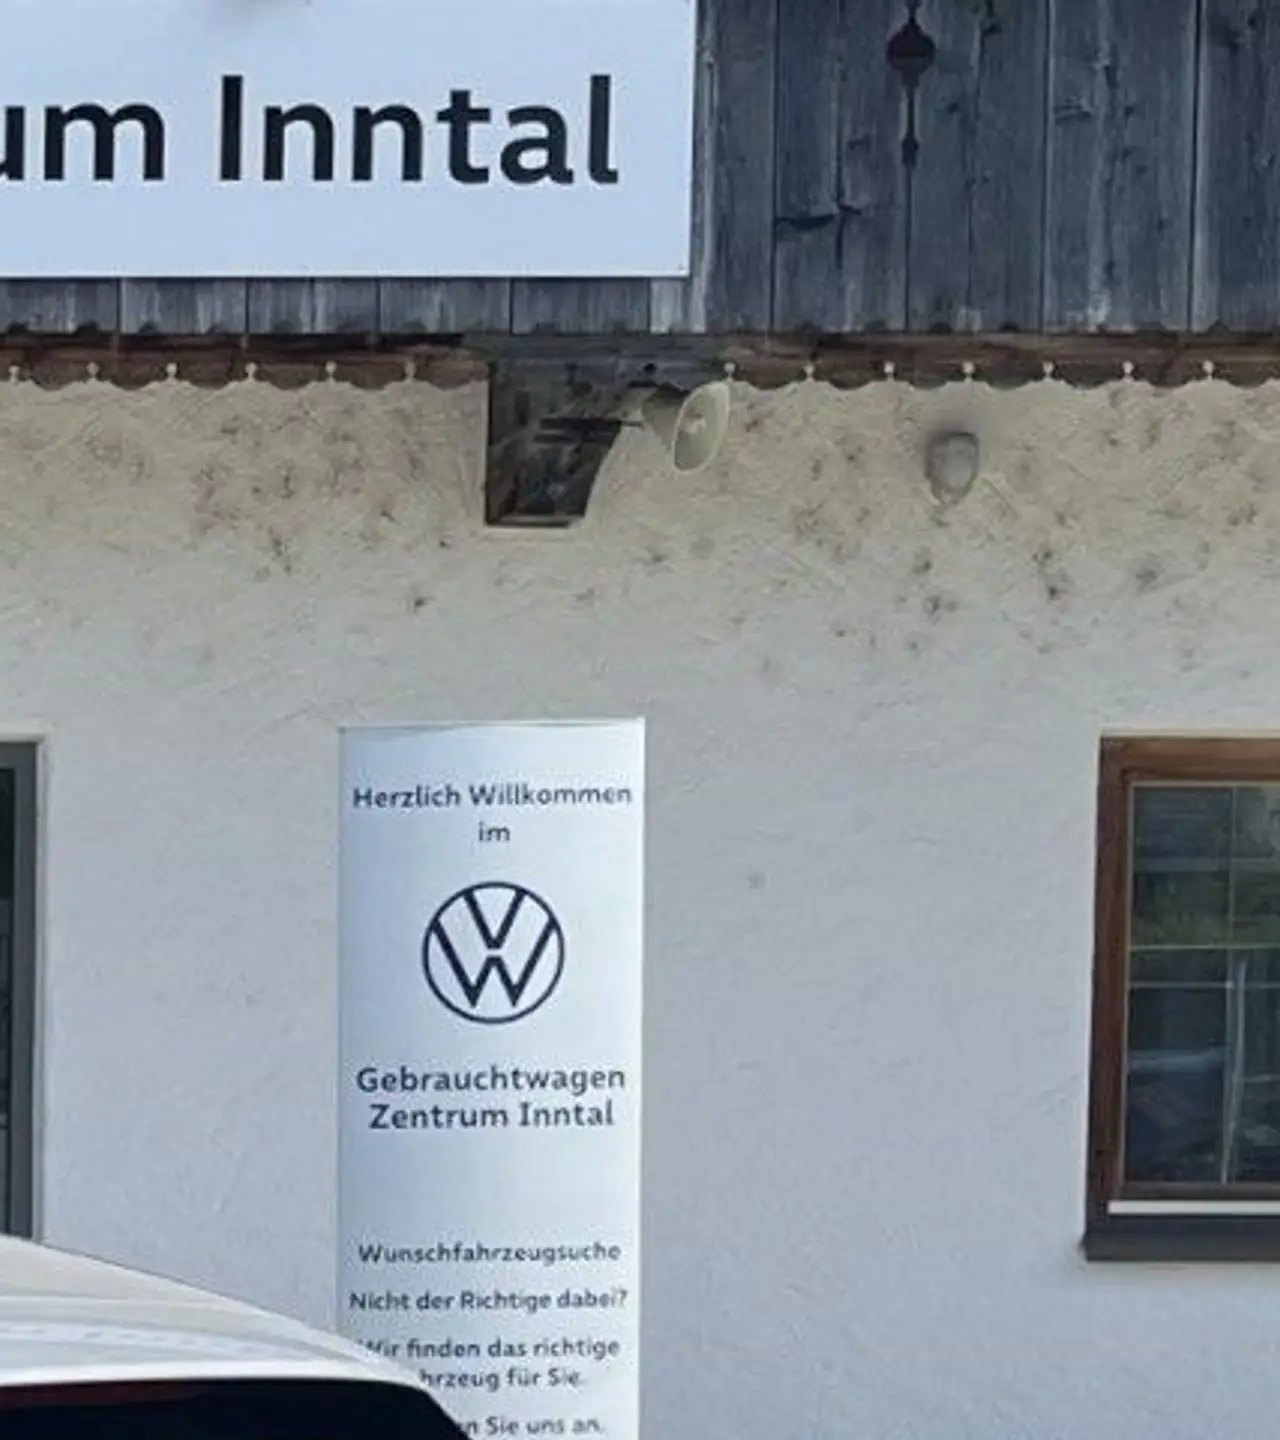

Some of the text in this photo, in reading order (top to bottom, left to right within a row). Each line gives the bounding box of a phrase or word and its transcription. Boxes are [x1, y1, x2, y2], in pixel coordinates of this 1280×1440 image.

[220, 73, 619, 187] Inntal
[352, 784, 632, 809] Herzlich Willkommen
[478, 821, 511, 843] im
[422, 881, 565, 1025] VW
[356, 1066, 626, 1098] Gebrauchtwagen
[369, 1101, 614, 1130] Zentrum Inntal
[358, 1241, 622, 1266] Wunschfahrzeugsuche
[349, 1288, 629, 1313] Nicht der Richtige dabei?
[406, 1337, 481, 1358] finden
[488, 1337, 528, 1358] das
[534, 1336, 621, 1360] richtige
[419, 1368, 500, 1393] hrzeug
[507, 1368, 542, 1386] für
[485, 1416, 520, 1435] Sie
[526, 1418, 565, 1435] uns
